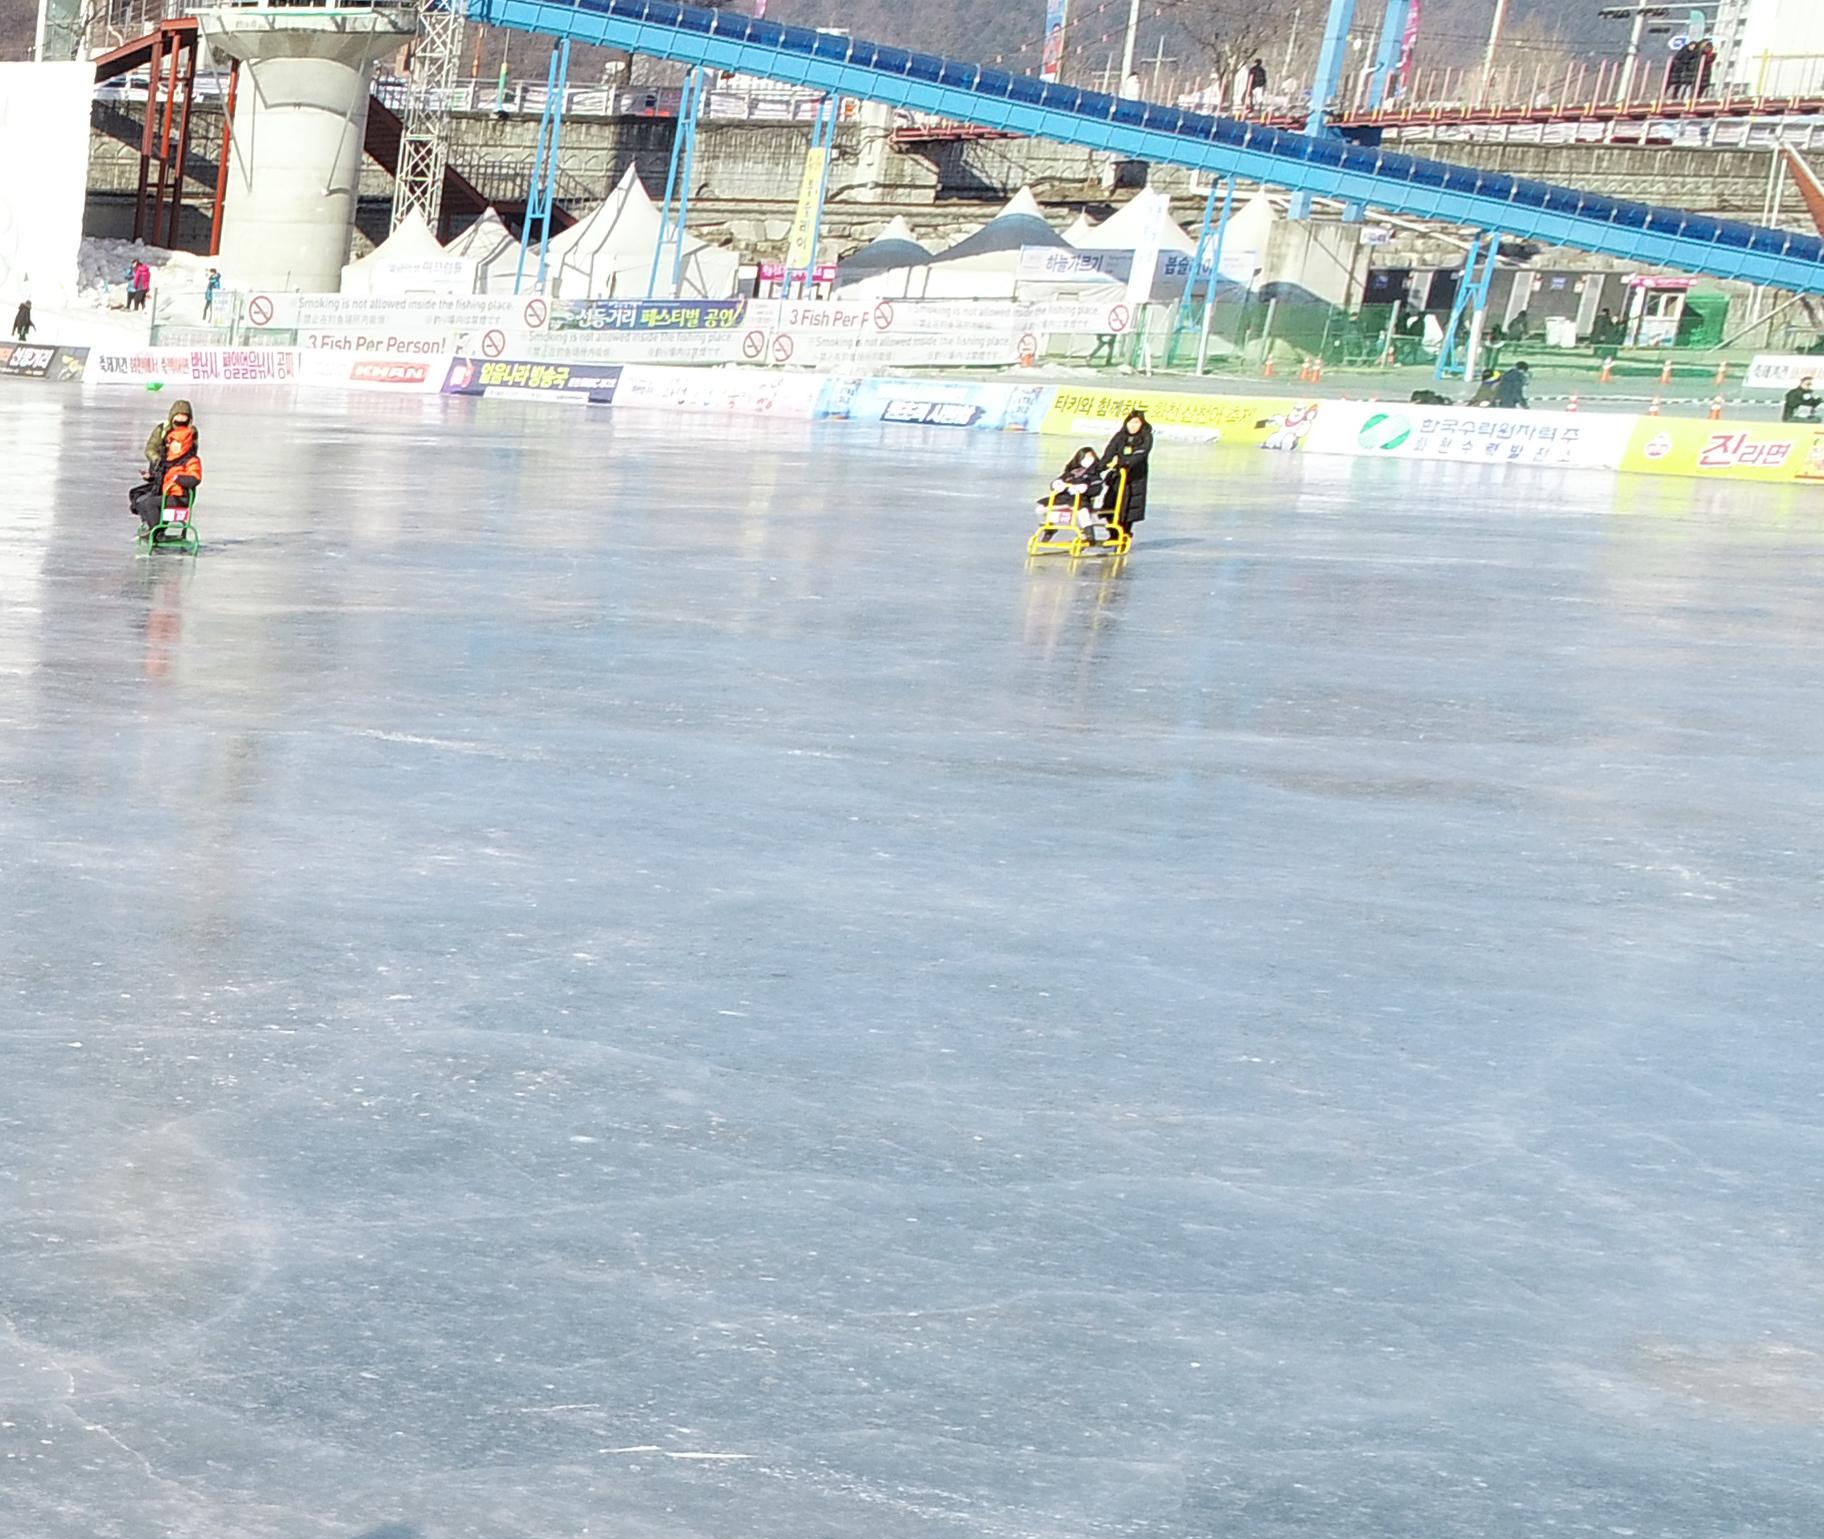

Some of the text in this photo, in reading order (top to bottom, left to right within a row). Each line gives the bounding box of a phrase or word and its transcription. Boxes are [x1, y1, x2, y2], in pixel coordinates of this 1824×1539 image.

[640, 308, 699, 328] 페스티벌
[704, 308, 737, 328] 공연
[789, 309, 798, 325] 3
[801, 310, 830, 326] Fish
[832, 311, 858, 327] Per
[320, 335, 352, 350] Fish
[355, 336, 383, 351] Per
[386, 337, 446, 354] Person!
[354, 366, 425, 379] KHAN
[478, 362, 529, 386] 얼음나라
[529, 364, 570, 388] 방송국
[1699, 433, 1792, 466] 진라면
